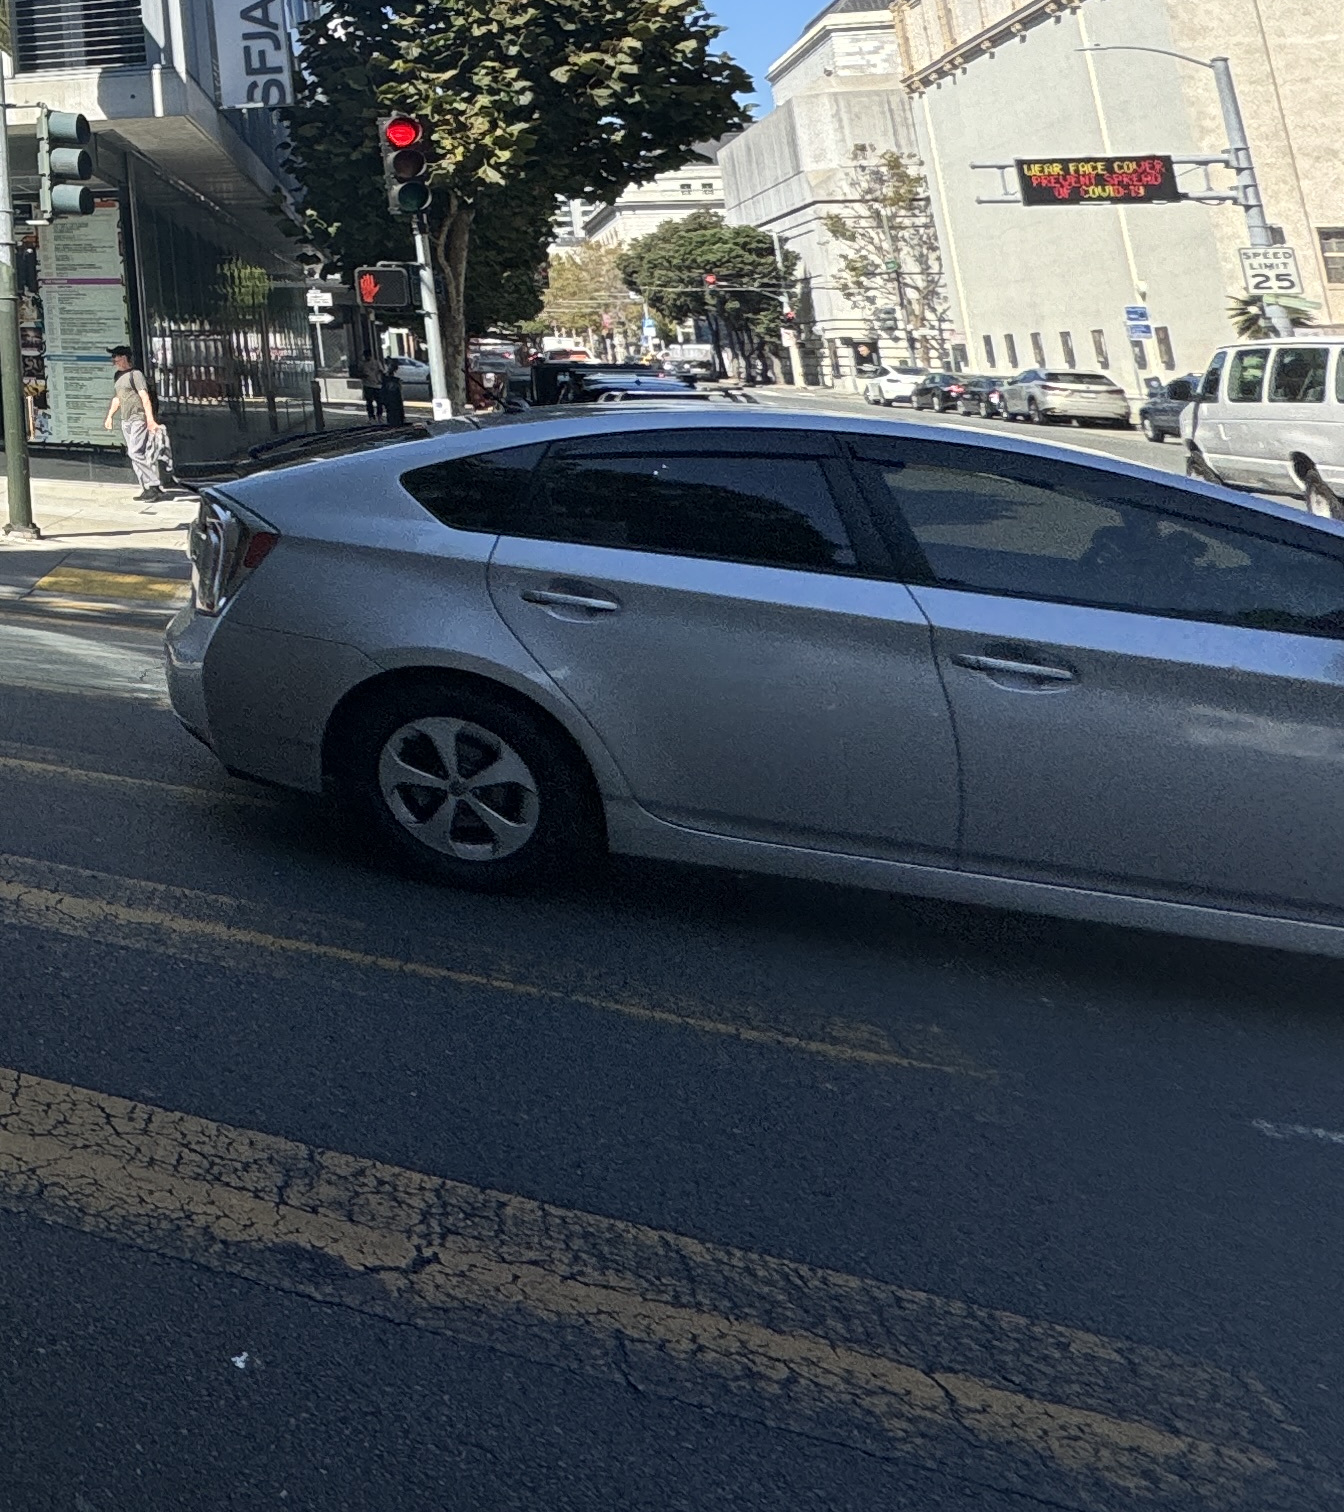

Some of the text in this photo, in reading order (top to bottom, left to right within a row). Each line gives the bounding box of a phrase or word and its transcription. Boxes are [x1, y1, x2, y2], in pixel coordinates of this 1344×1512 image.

[1023, 160, 1165, 176] WEAR FACE COVER
[1031, 172, 1162, 187] PREVENT SPREAD
[1053, 185, 1145, 199] OF COVID-19
[1242, 251, 1293, 260] SPEED
[1249, 262, 1290, 270] LIMIT
[1251, 273, 1296, 290] 25
